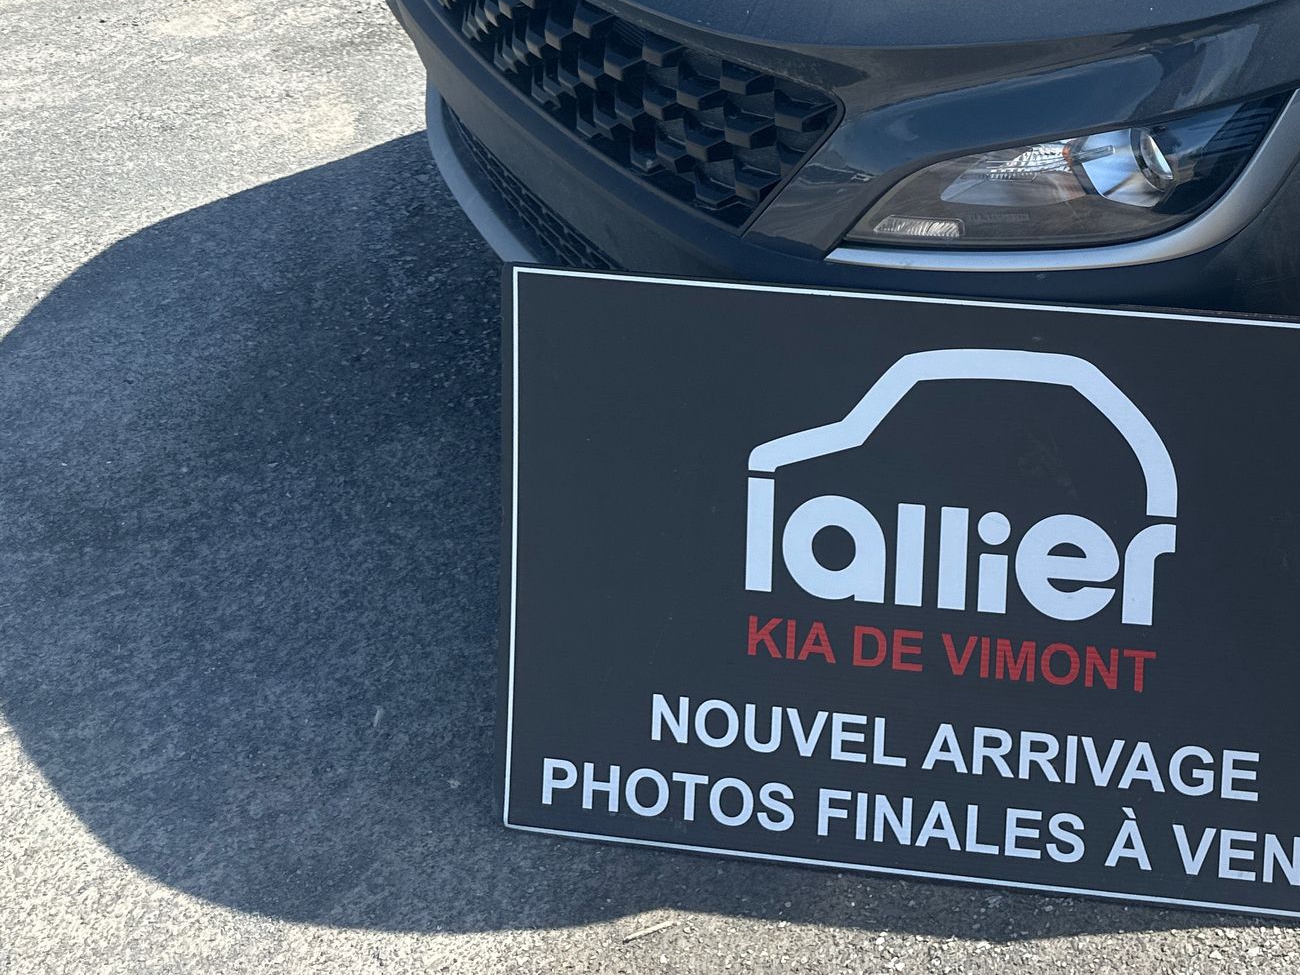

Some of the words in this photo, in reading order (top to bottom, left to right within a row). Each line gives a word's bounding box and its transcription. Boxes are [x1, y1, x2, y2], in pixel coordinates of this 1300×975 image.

[747, 616, 835, 663] KIA
[853, 625, 923, 671] DE
[942, 633, 1156, 692] VIMONT
[651, 693, 907, 768] NOUVEL
[921, 723, 1260, 802] ARRIVAGE
[541, 757, 795, 832] PHOTOS
[817, 788, 1085, 863] FINALES
[1104, 806, 1152, 871] À
